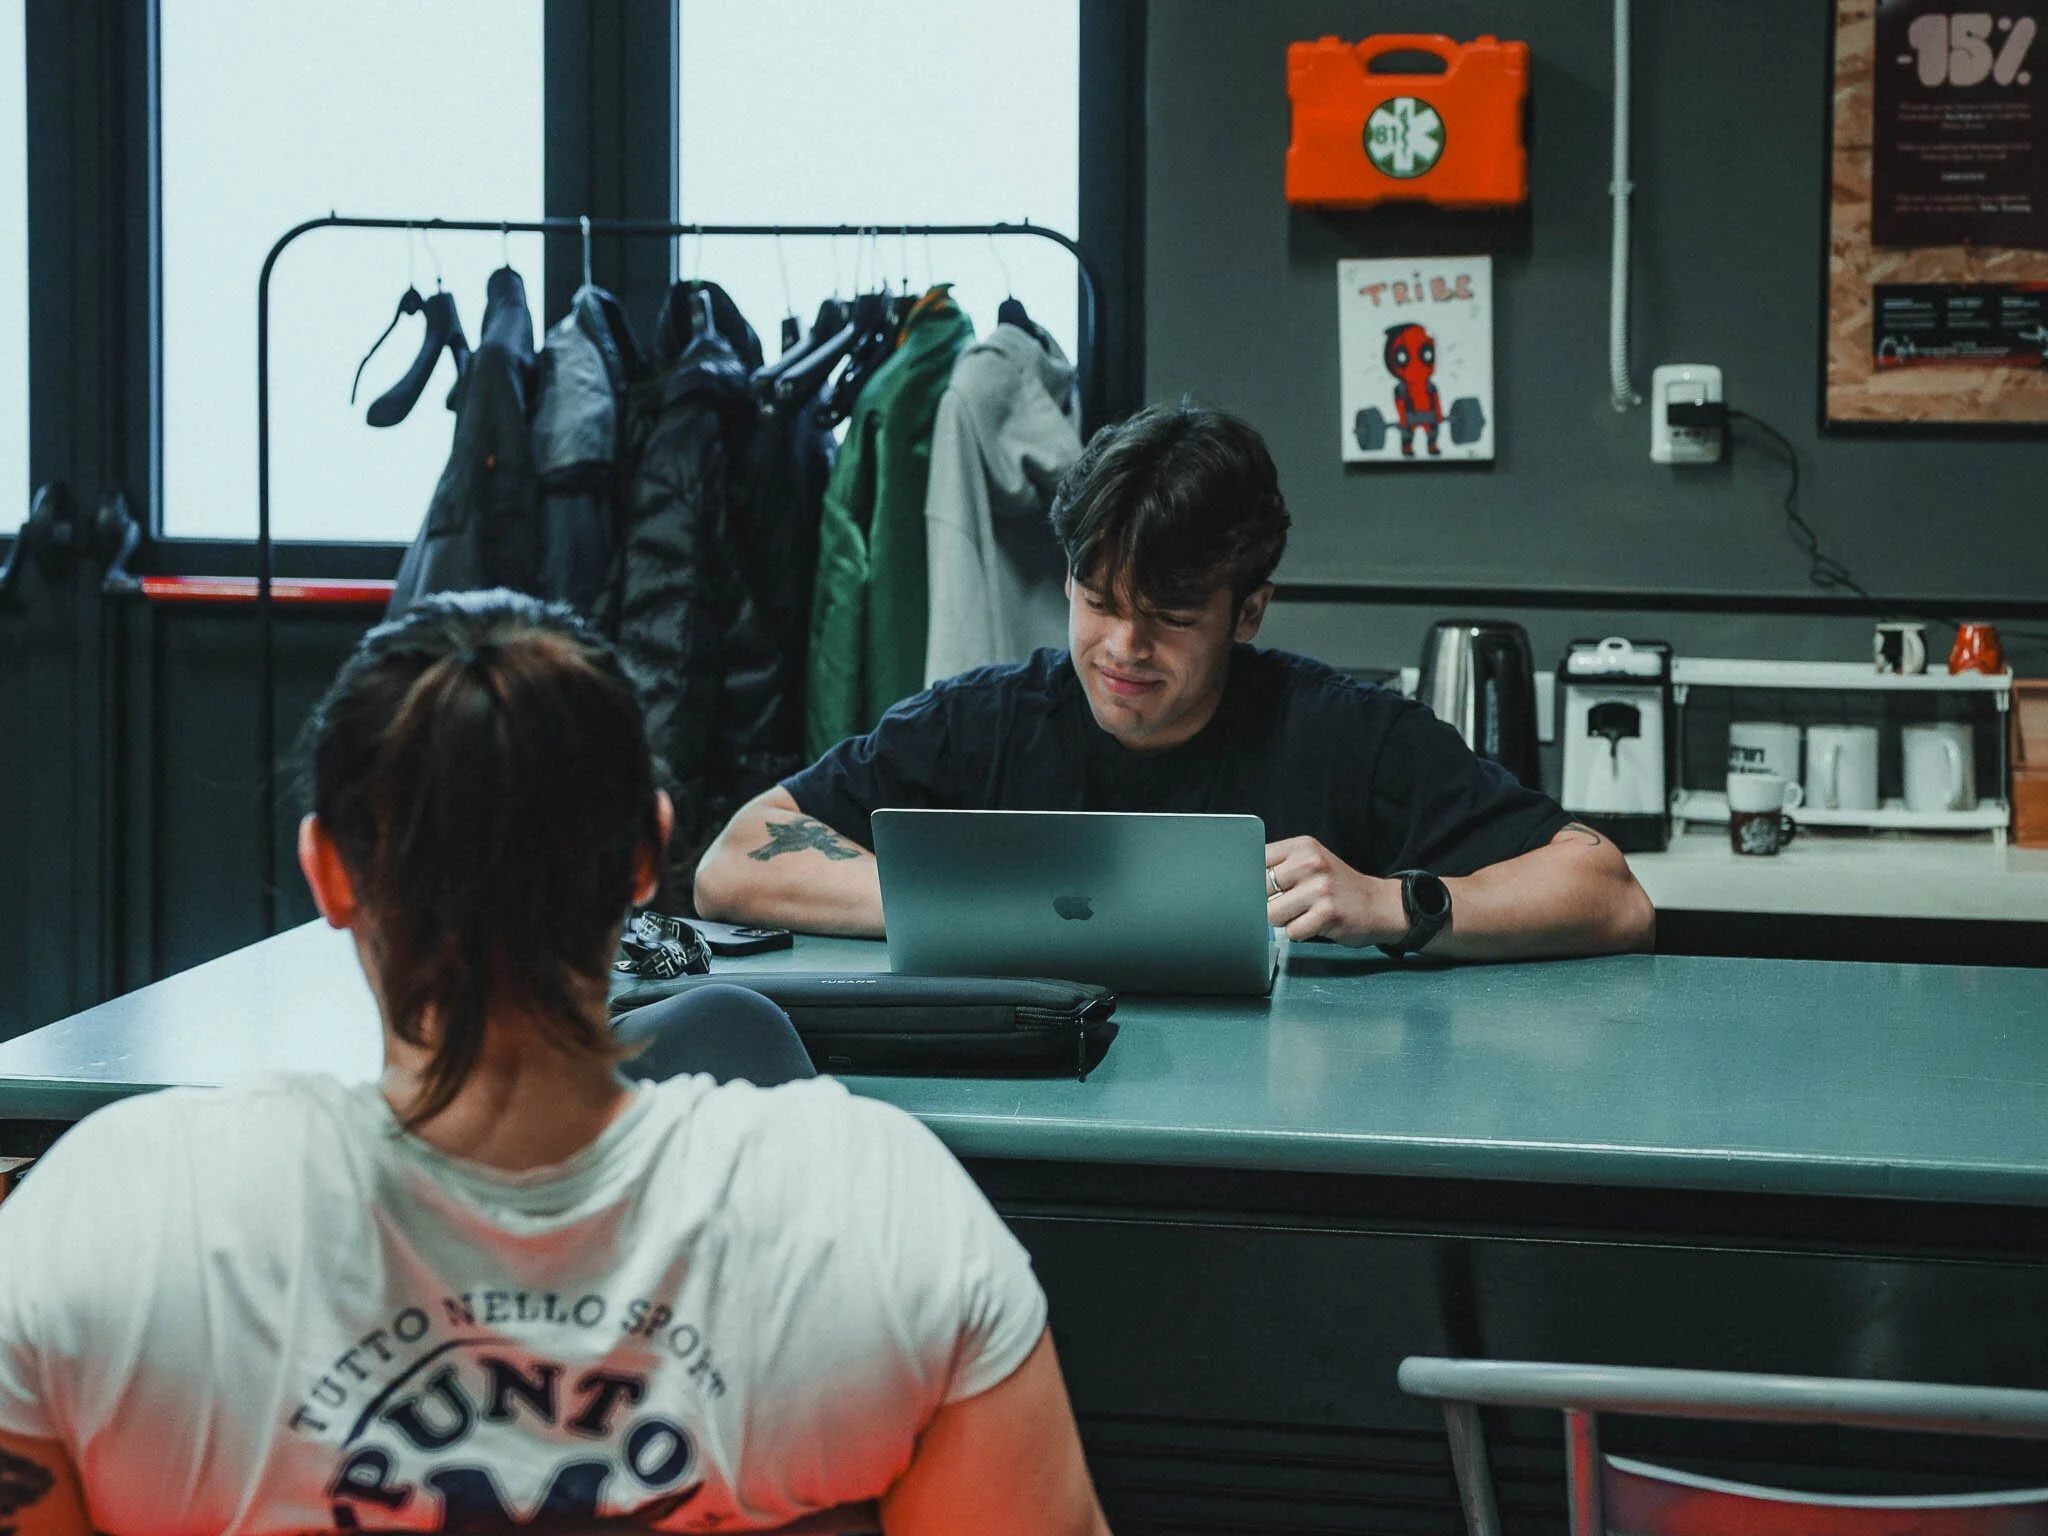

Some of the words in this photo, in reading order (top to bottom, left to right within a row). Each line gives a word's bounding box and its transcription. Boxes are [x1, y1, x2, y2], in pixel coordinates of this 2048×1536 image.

[1897, 13, 2037, 87] -15%
[289, 1306, 430, 1433] TUTTO
[442, 1291, 607, 1328] NELLO
[326, 1355, 693, 1511] PUNTO
